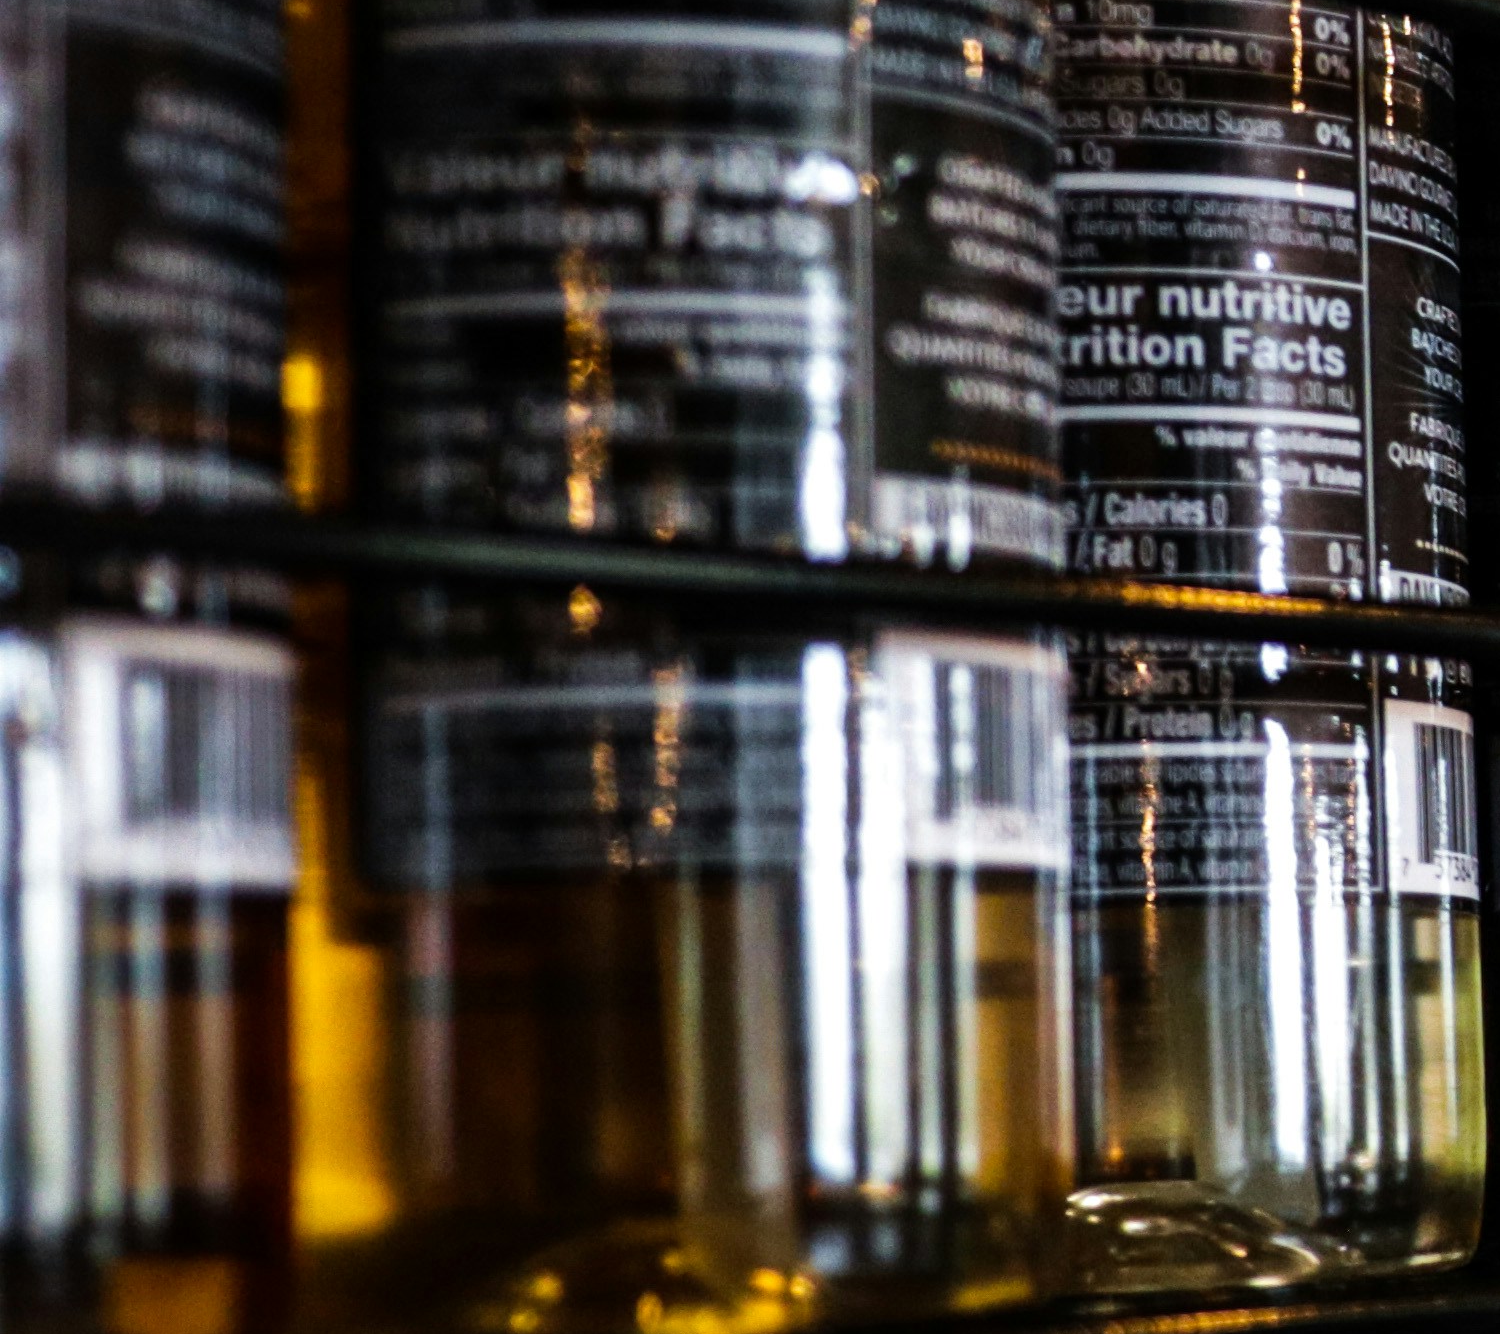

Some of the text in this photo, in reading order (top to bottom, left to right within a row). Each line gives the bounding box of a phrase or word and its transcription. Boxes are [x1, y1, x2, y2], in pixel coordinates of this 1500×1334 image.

[1314, 17, 1350, 46] 0%
[1244, 41, 1350, 80] 0g 0%
[1107, 105, 1352, 151] 0g Added Sugars 0%
[1080, 140, 1116, 173] 0g
[1158, 279, 1351, 331] nutritive
[1222, 327, 1347, 377] Facts
[1211, 376, 1242, 400] Per
[1182, 427, 1248, 448] valeur
[1313, 463, 1362, 489] Value
[1104, 492, 1207, 526] Calories
[1092, 535, 1135, 567] Fat
